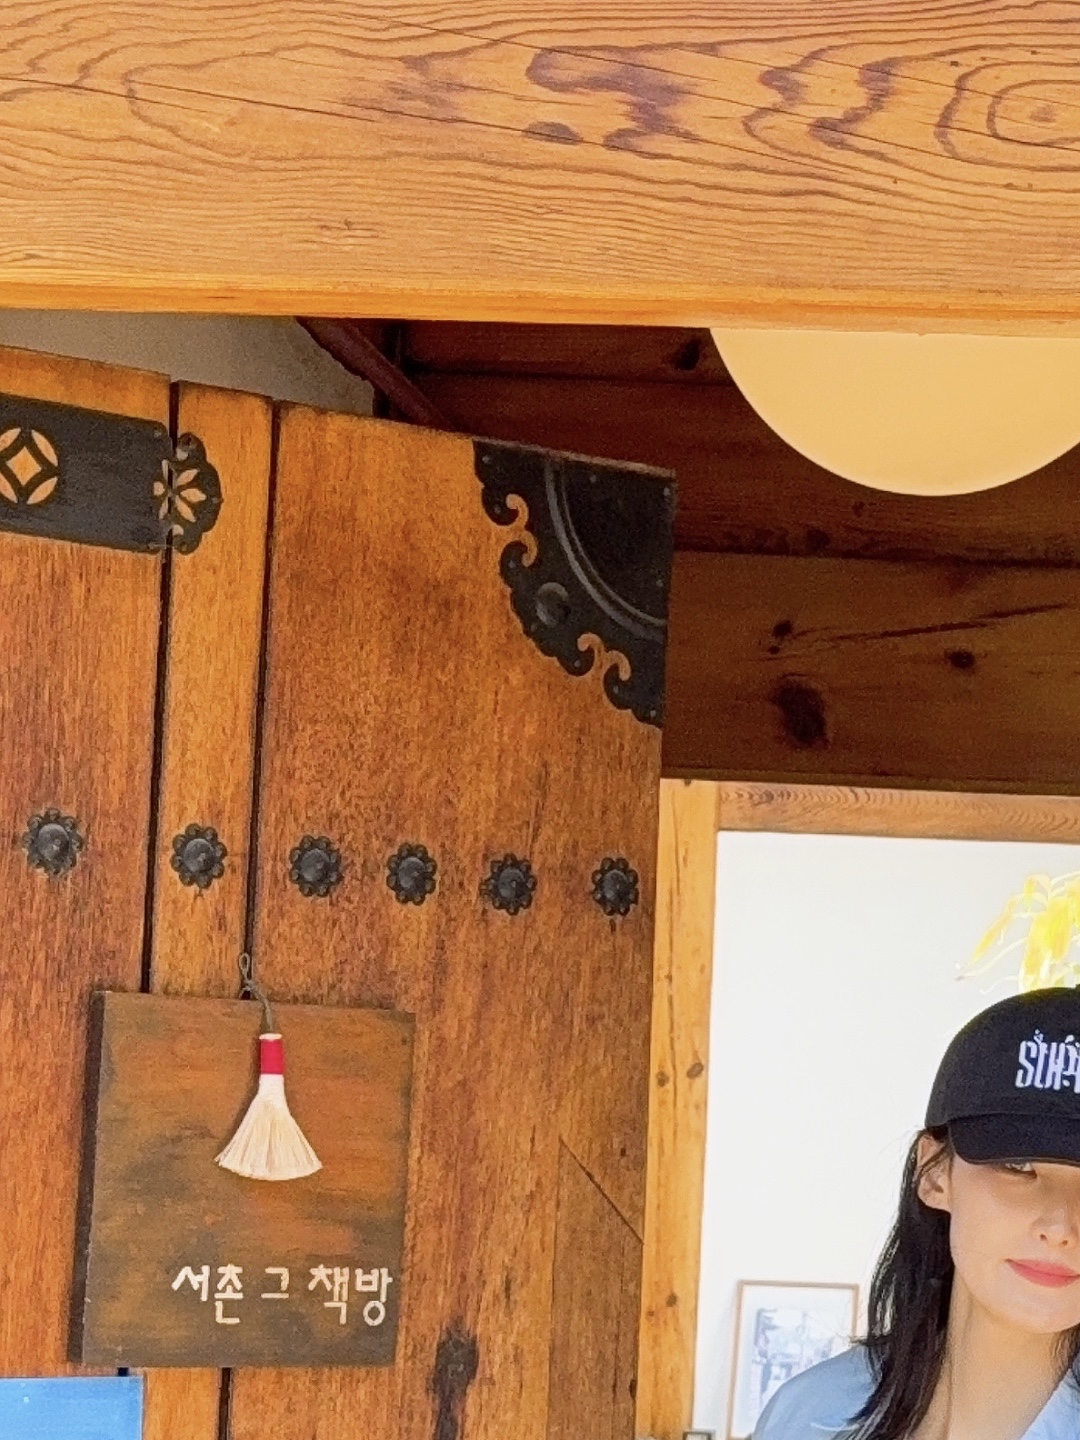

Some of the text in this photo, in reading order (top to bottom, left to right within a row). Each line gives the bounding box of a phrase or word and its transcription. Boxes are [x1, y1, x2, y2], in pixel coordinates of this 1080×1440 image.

[171, 1263, 394, 1327] 서촌 그 책방
